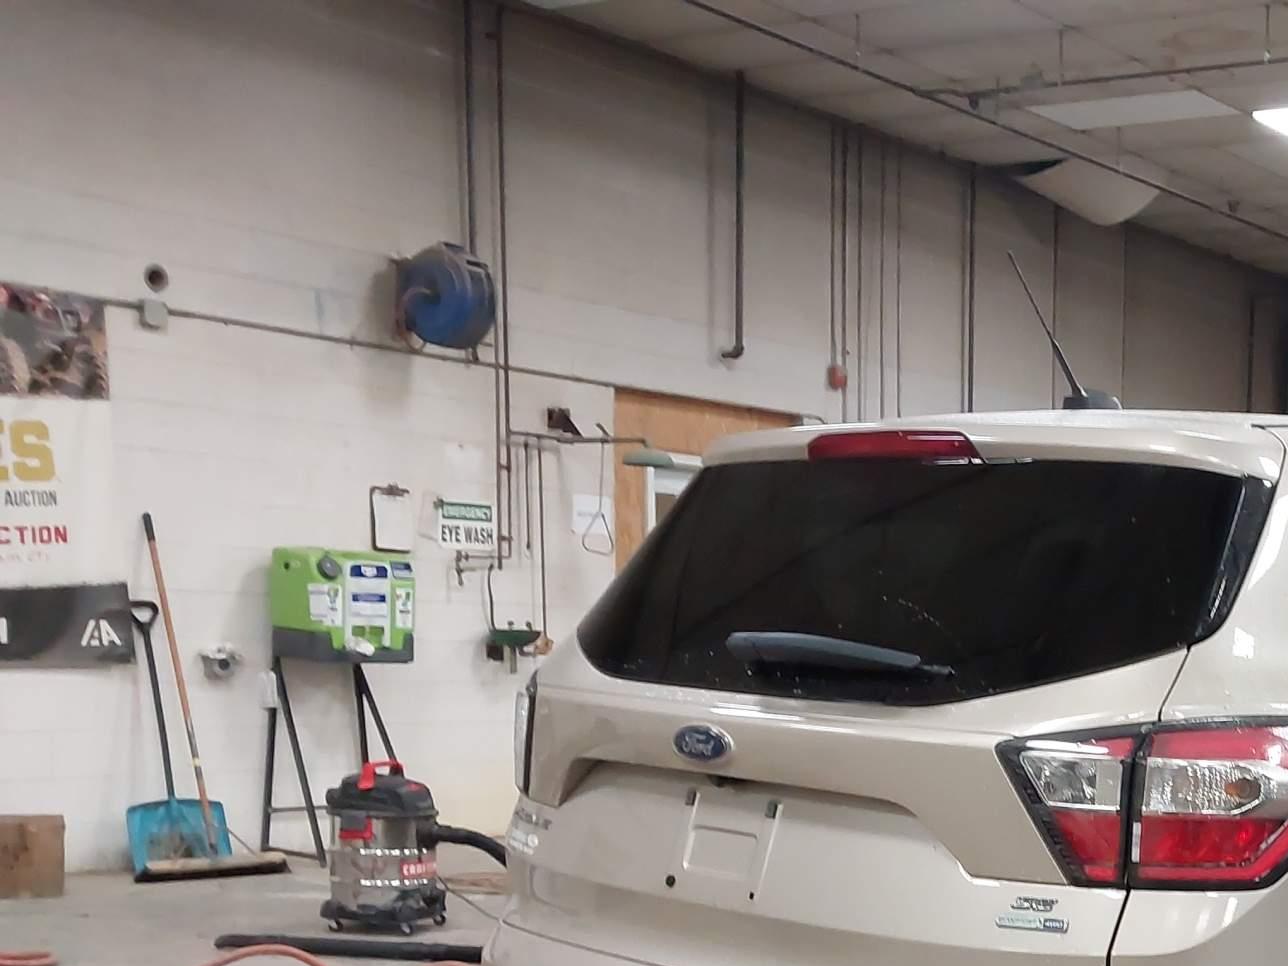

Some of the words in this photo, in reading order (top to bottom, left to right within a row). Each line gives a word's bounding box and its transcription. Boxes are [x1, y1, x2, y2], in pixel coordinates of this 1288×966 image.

[5, 489, 58, 507] AUCTION
[441, 524, 461, 542] EYE
[463, 526, 493, 545] WASH
